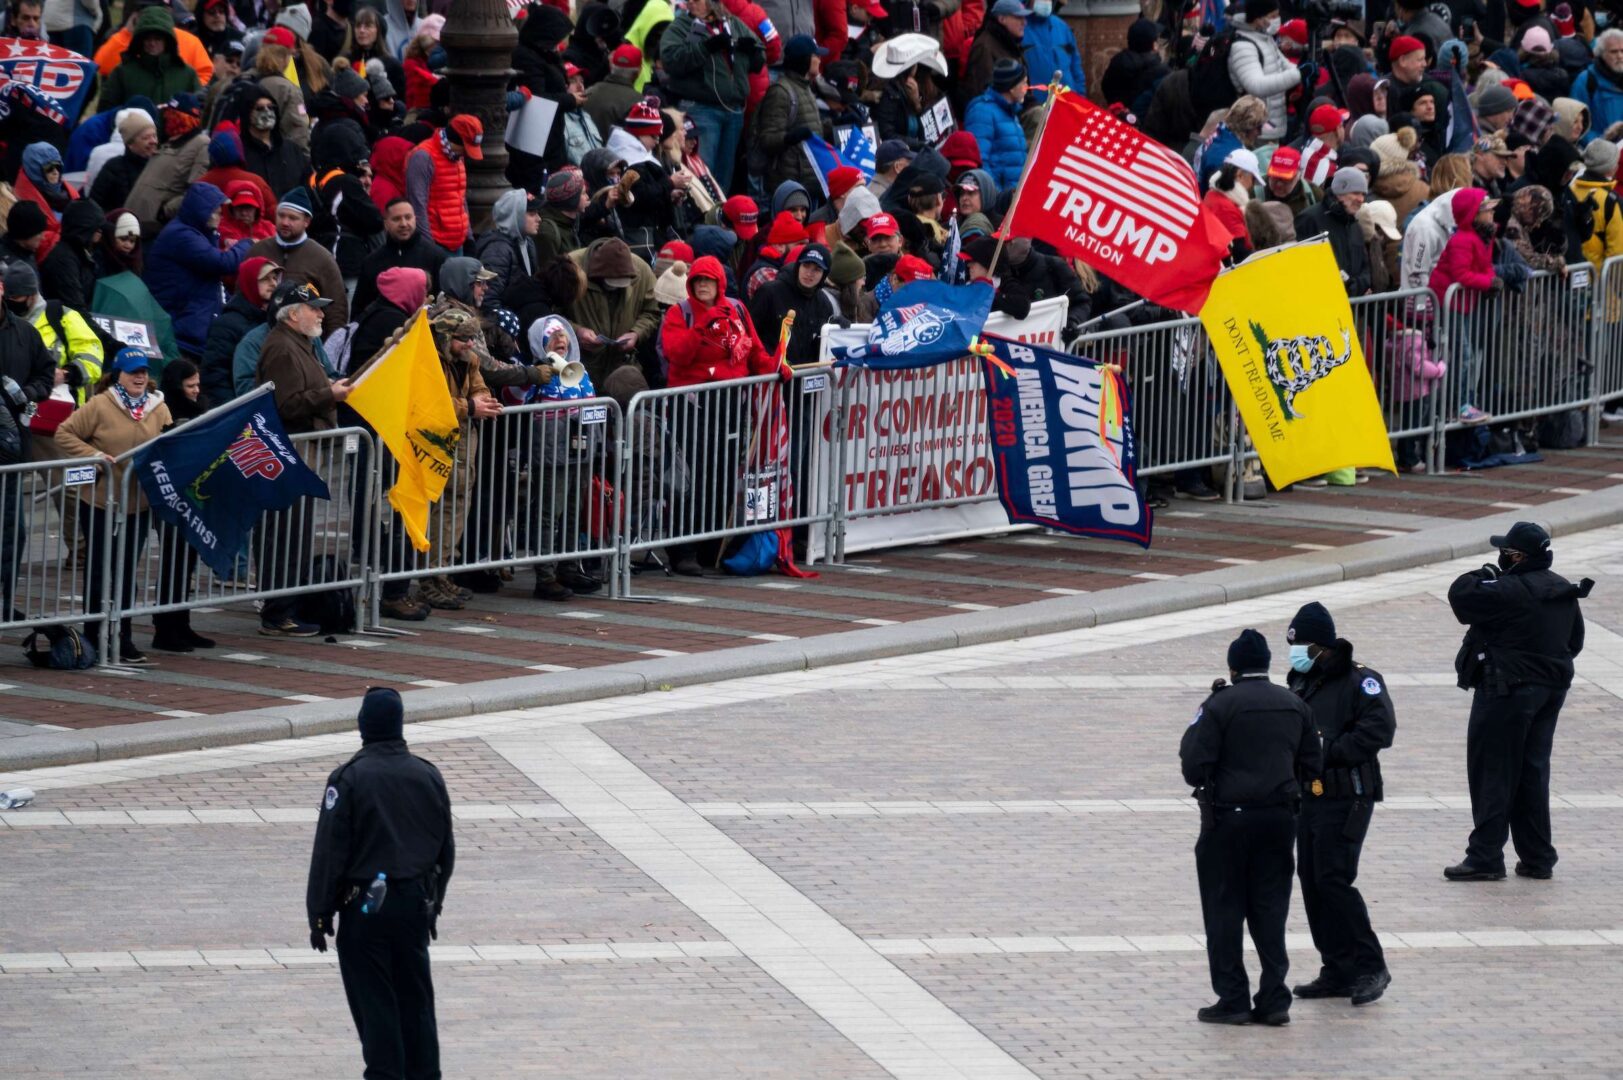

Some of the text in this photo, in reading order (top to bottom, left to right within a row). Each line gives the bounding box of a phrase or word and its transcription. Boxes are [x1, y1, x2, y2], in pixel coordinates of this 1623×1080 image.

[1042, 180, 1178, 265] TRUMP
[1064, 225, 1124, 266] NATION
[1243, 359, 1268, 402] TREAD
[583, 411, 594, 420] LONG
[992, 396, 1017, 447] 2020
[1014, 367, 1050, 460] AMERICA
[1260, 401, 1277, 420] ON
[1267, 421, 1285, 442] ME
[67, 471, 80, 481] LONG
[149, 460, 178, 500] KEEP
[845, 456, 998, 519] TREASO
